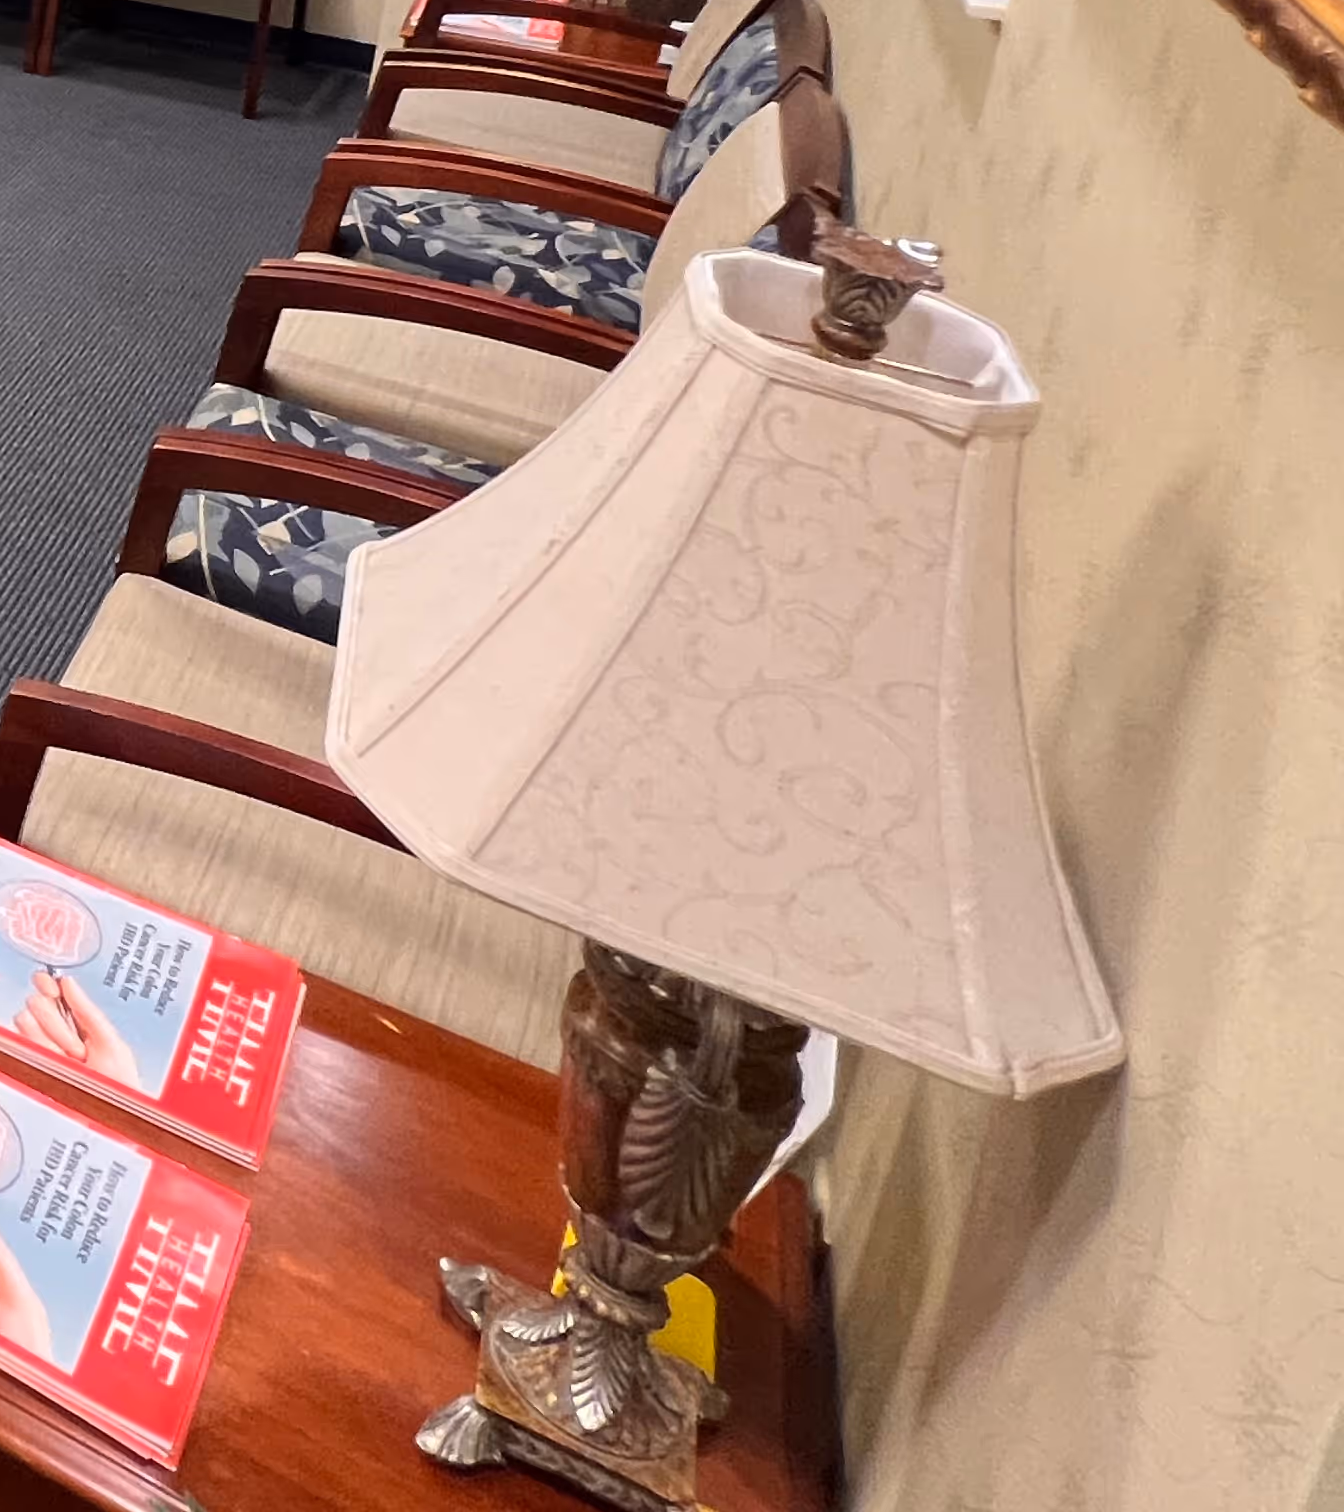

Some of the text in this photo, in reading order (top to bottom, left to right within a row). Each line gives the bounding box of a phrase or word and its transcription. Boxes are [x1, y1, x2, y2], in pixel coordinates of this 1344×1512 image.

[102, 921, 138, 990] IBD Patients
[117, 922, 157, 1003] Cancer Risk for
[138, 940, 171, 1001] Your Colon
[153, 937, 192, 1018] How to Reduce
[182, 978, 275, 1107] TIME
[207, 991, 249, 1083] HEALTH
[17, 1138, 67, 1226] IBD Patients
[33, 1139, 89, 1245] Cancer Risk for
[59, 1163, 103, 1243] Your Colon
[74, 1160, 128, 1266] How to Reduce
[102, 1214, 219, 1387] TIME
[132, 1232, 190, 1354] HEALTH
